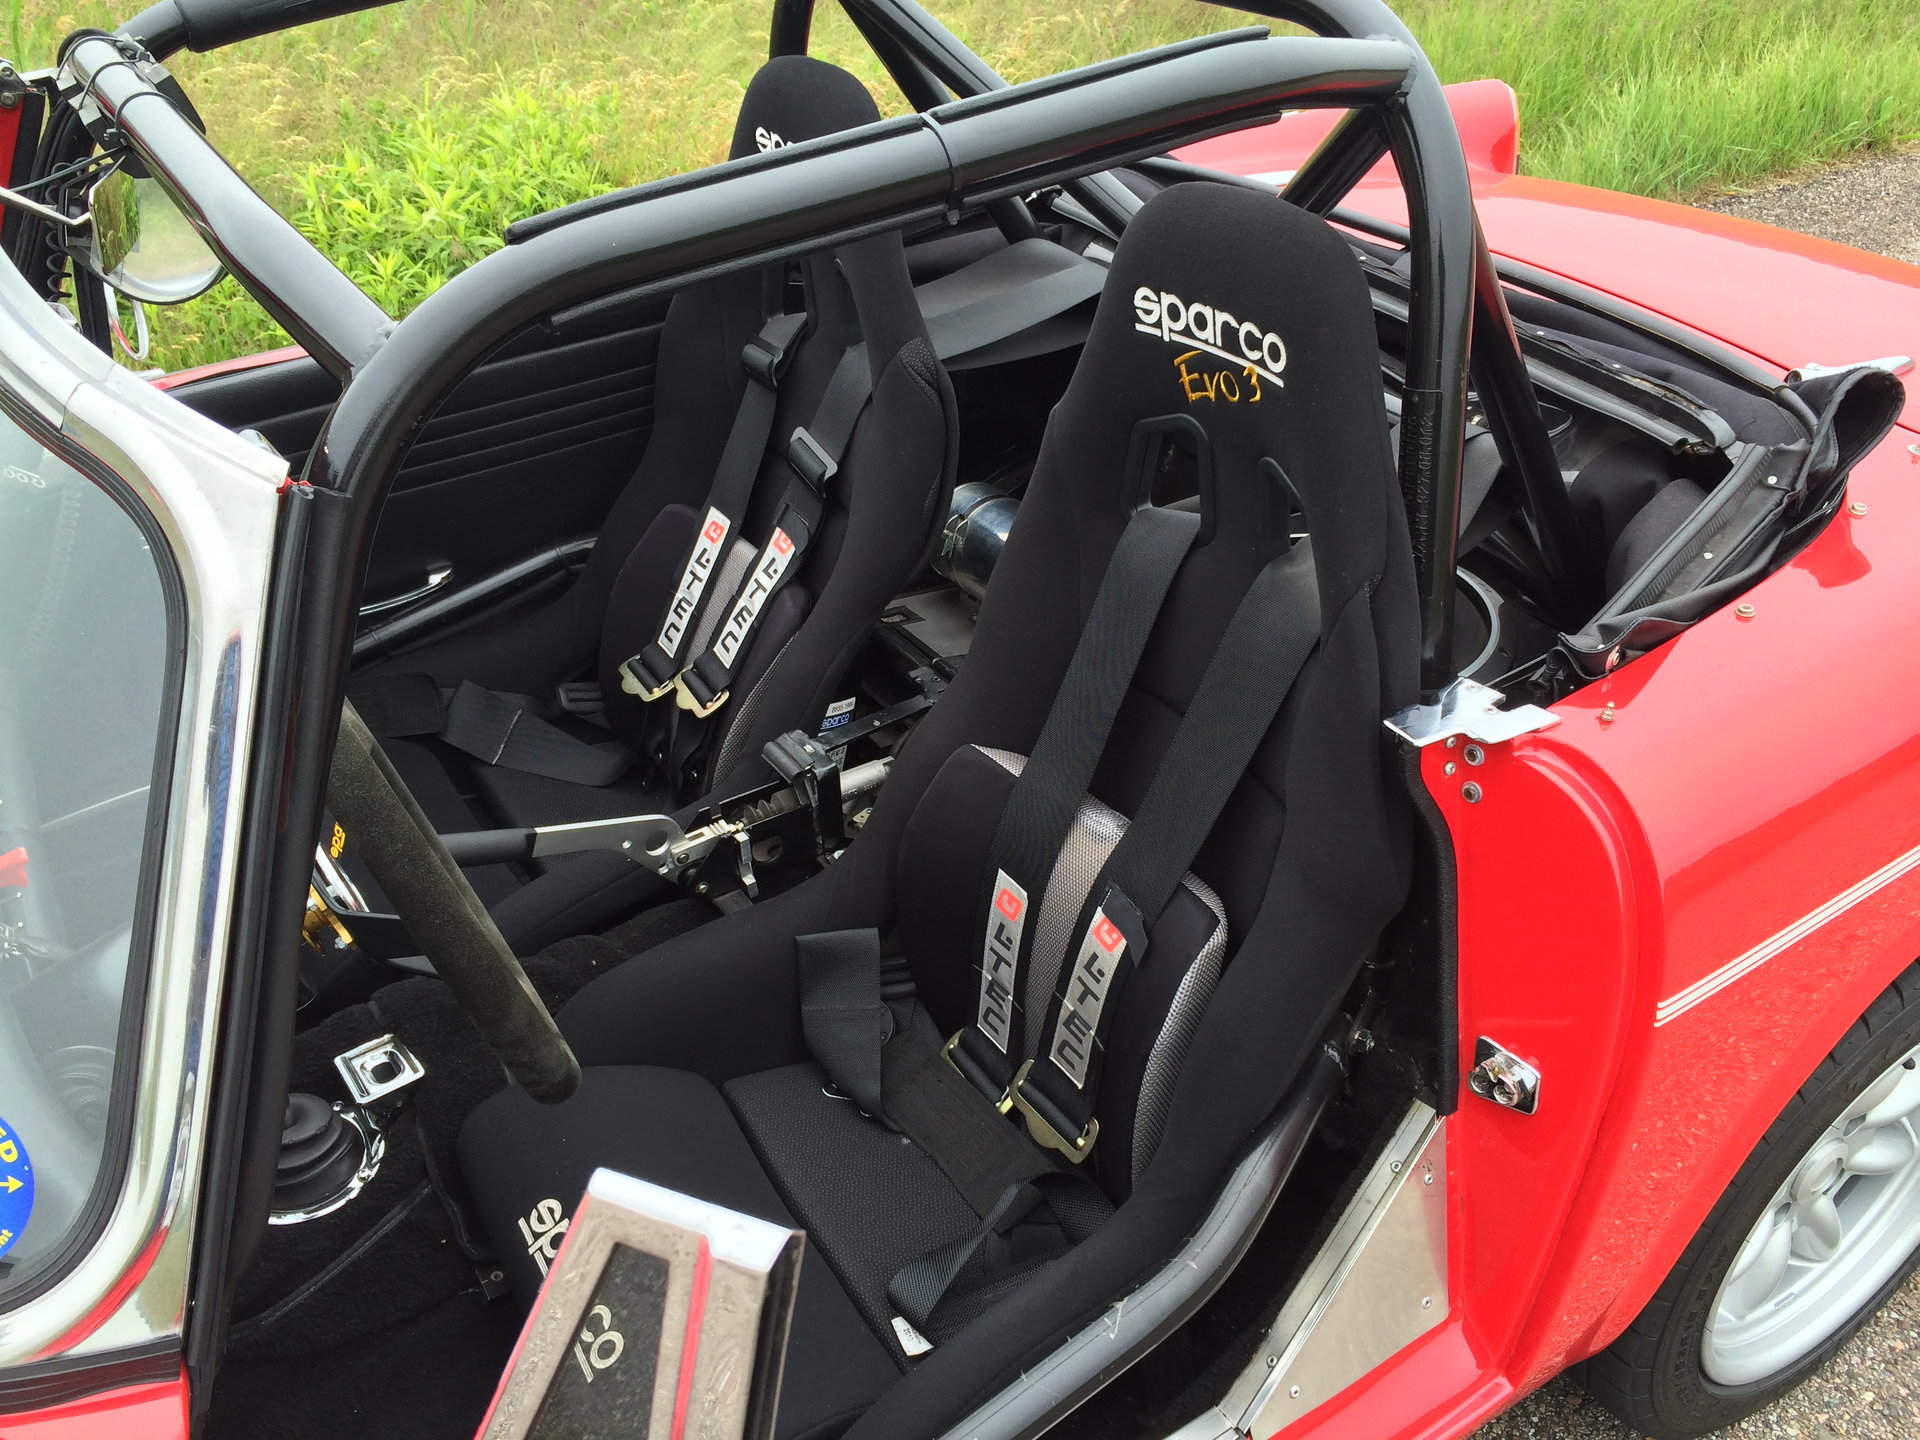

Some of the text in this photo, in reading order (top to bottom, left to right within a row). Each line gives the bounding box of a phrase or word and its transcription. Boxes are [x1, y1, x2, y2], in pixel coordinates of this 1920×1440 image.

[1133, 286, 1287, 380] sparco
[1173, 350, 1240, 402] Evo
[821, 713, 850, 729] sparco
